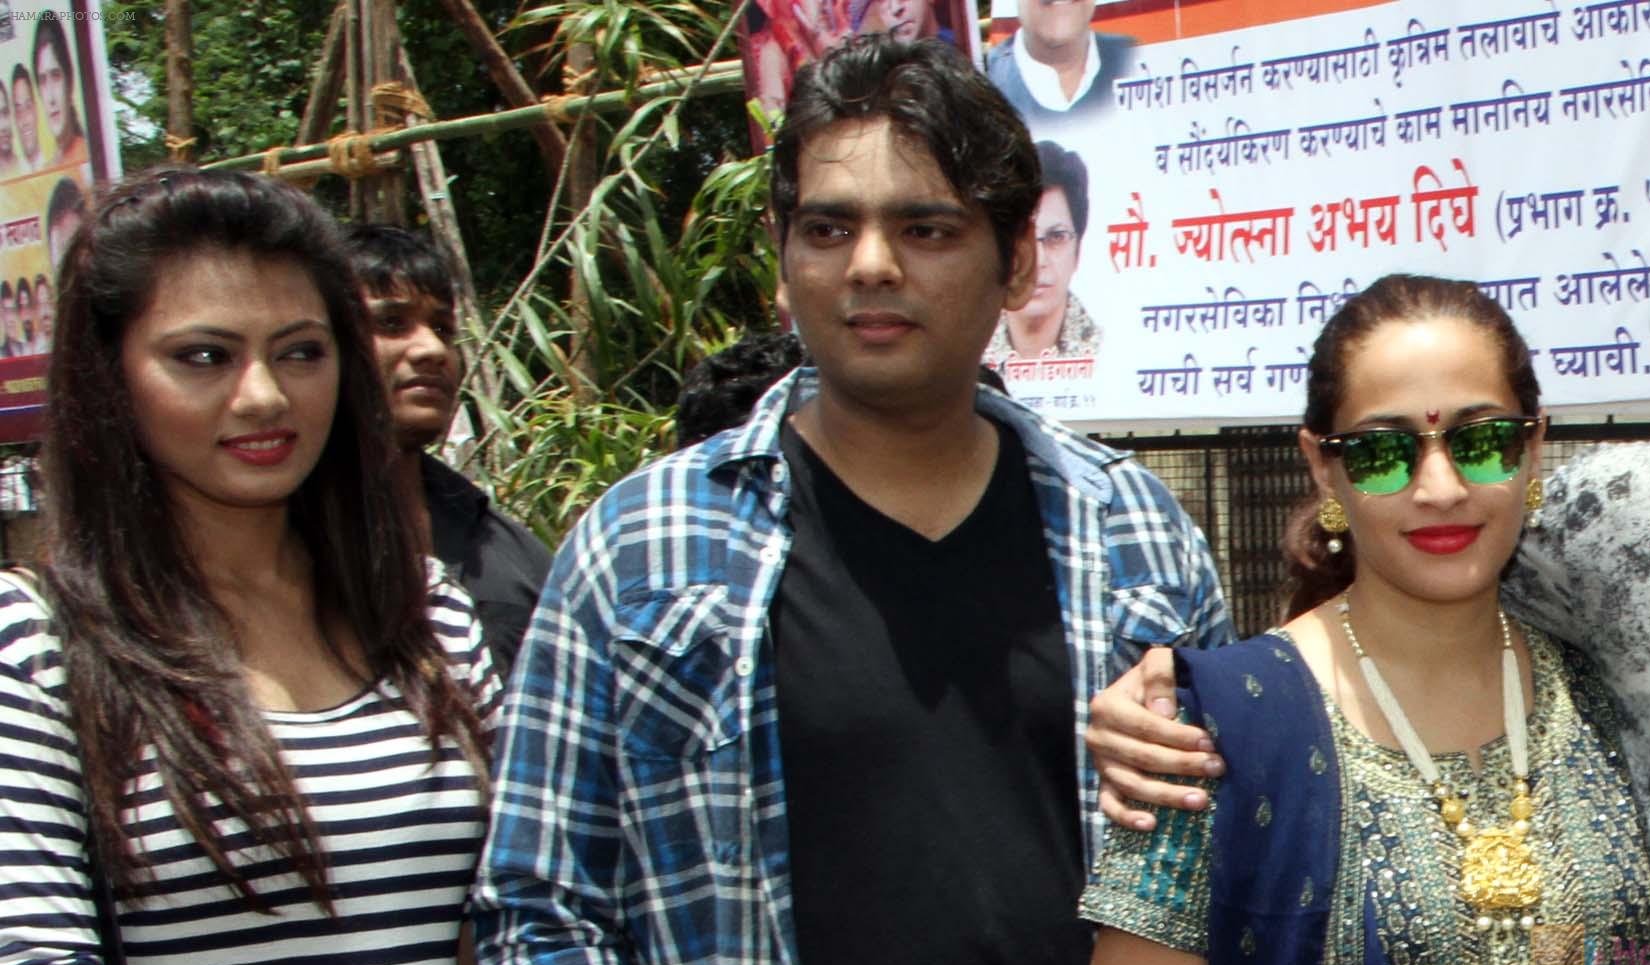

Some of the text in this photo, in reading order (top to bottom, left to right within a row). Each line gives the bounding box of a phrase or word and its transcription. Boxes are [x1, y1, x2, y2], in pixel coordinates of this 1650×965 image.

[1117, 62, 1173, 110] गणेश
[1180, 45, 1254, 103] विसर्जन
[1261, 27, 1380, 91] करण्यासाठी
[1387, 18, 1450, 88] कृत्रिम
[1155, 145, 1171, 173] व
[1298, 98, 1387, 158] करण्याचे
[1395, 106, 1442, 145] काम
[1107, 192, 1157, 273] सौ.
[1171, 188, 1295, 263] ज्योत्स्ना
[1307, 195, 1401, 253] अभय
[1411, 158, 1479, 252] दिघे
[1496, 189, 1585, 244] (प्रभाग
[1593, 186, 1630, 229] क्र.
[1142, 286, 1287, 333] नगरसेविका
[1137, 354, 1202, 397] याची
[1212, 347, 1255, 394] सर्व
